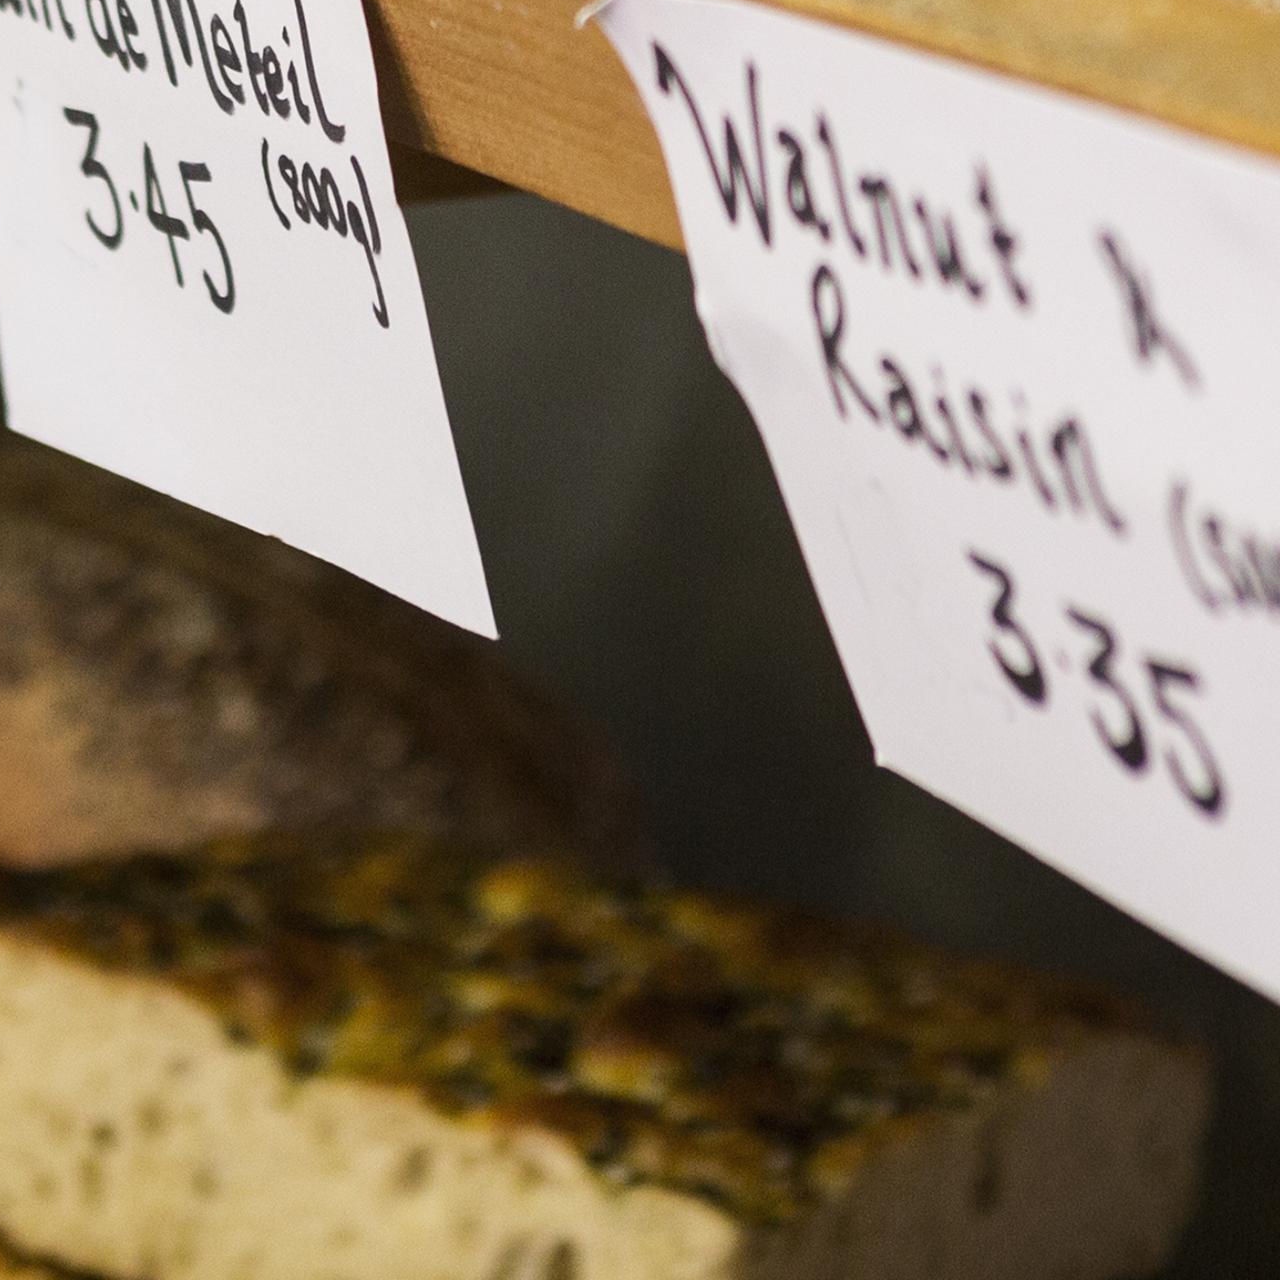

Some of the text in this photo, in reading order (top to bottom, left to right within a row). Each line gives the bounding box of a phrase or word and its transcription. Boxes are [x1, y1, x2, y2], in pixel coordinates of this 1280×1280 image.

[62, 106, 390, 328] 3.45 (800g)
[652, 38, 1034, 312] Walnut
[808, 264, 1130, 538] Raisin
[966, 548, 1228, 822] 3.35
